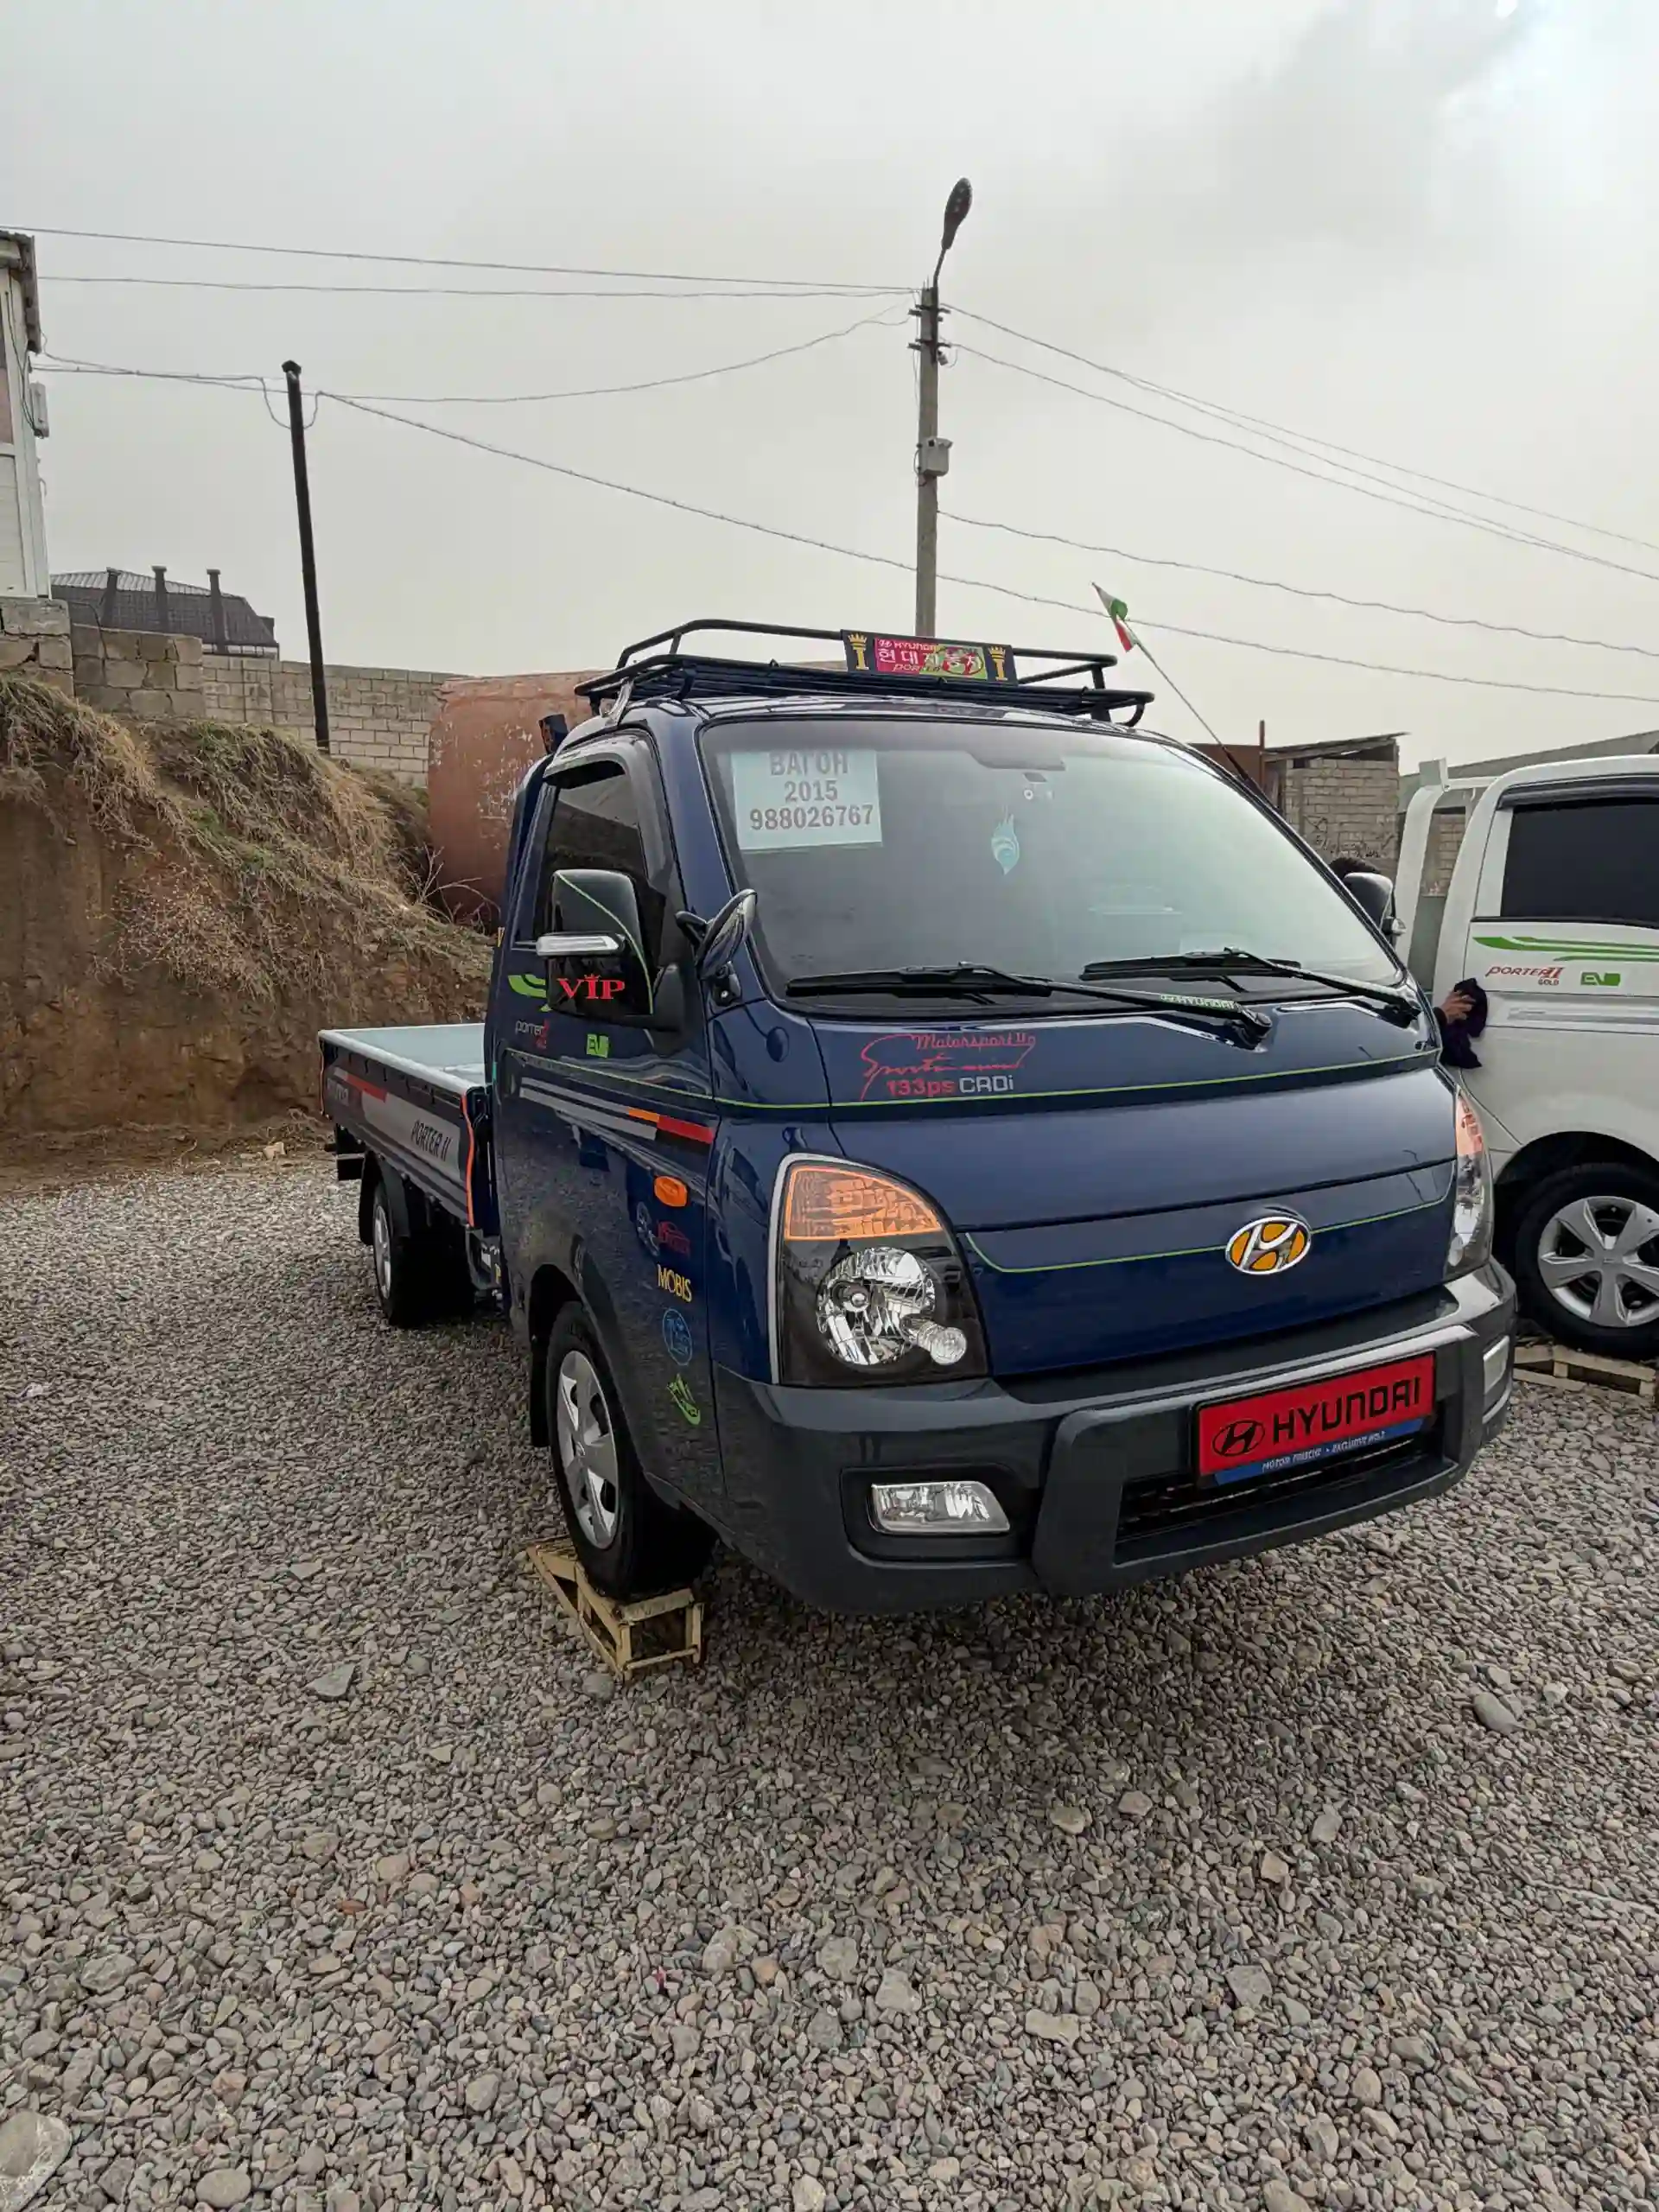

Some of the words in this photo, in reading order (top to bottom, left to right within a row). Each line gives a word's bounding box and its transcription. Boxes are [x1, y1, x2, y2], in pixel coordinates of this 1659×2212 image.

[784, 779, 838, 803] 2015
[749, 804, 874, 831] 988026767
[556, 976, 626, 1001] VIP
[886, 1077, 956, 1098] 133ps
[959, 1074, 1014, 1094] CRDi
[410, 1119, 444, 1158] PORTER
[657, 1263, 693, 1303] MOBIS
[1272, 1376, 1421, 1445] HYUNDAI
